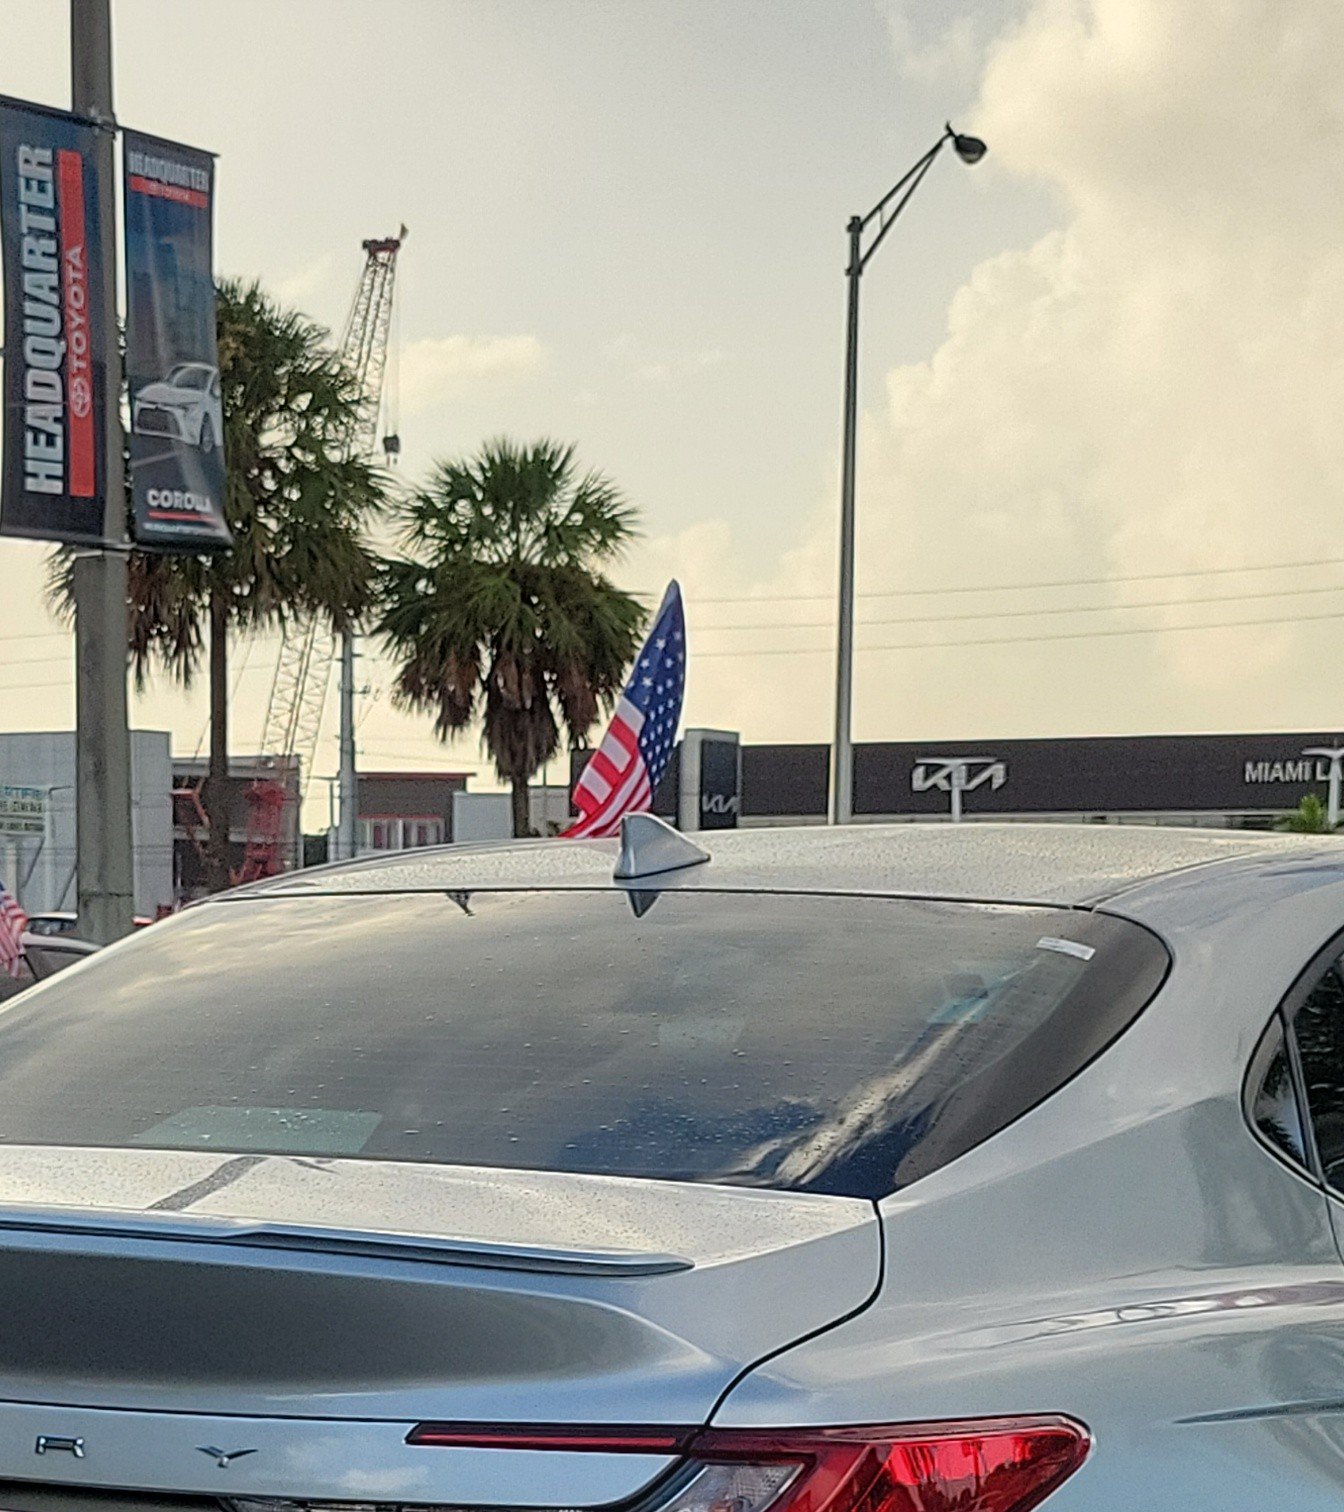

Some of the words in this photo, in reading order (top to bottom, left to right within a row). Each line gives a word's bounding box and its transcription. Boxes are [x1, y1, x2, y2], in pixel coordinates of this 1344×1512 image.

[18, 145, 67, 495] HEADQUARTER
[66, 246, 87, 373] TOYOTA
[1244, 760, 1312, 783] MIAMI
